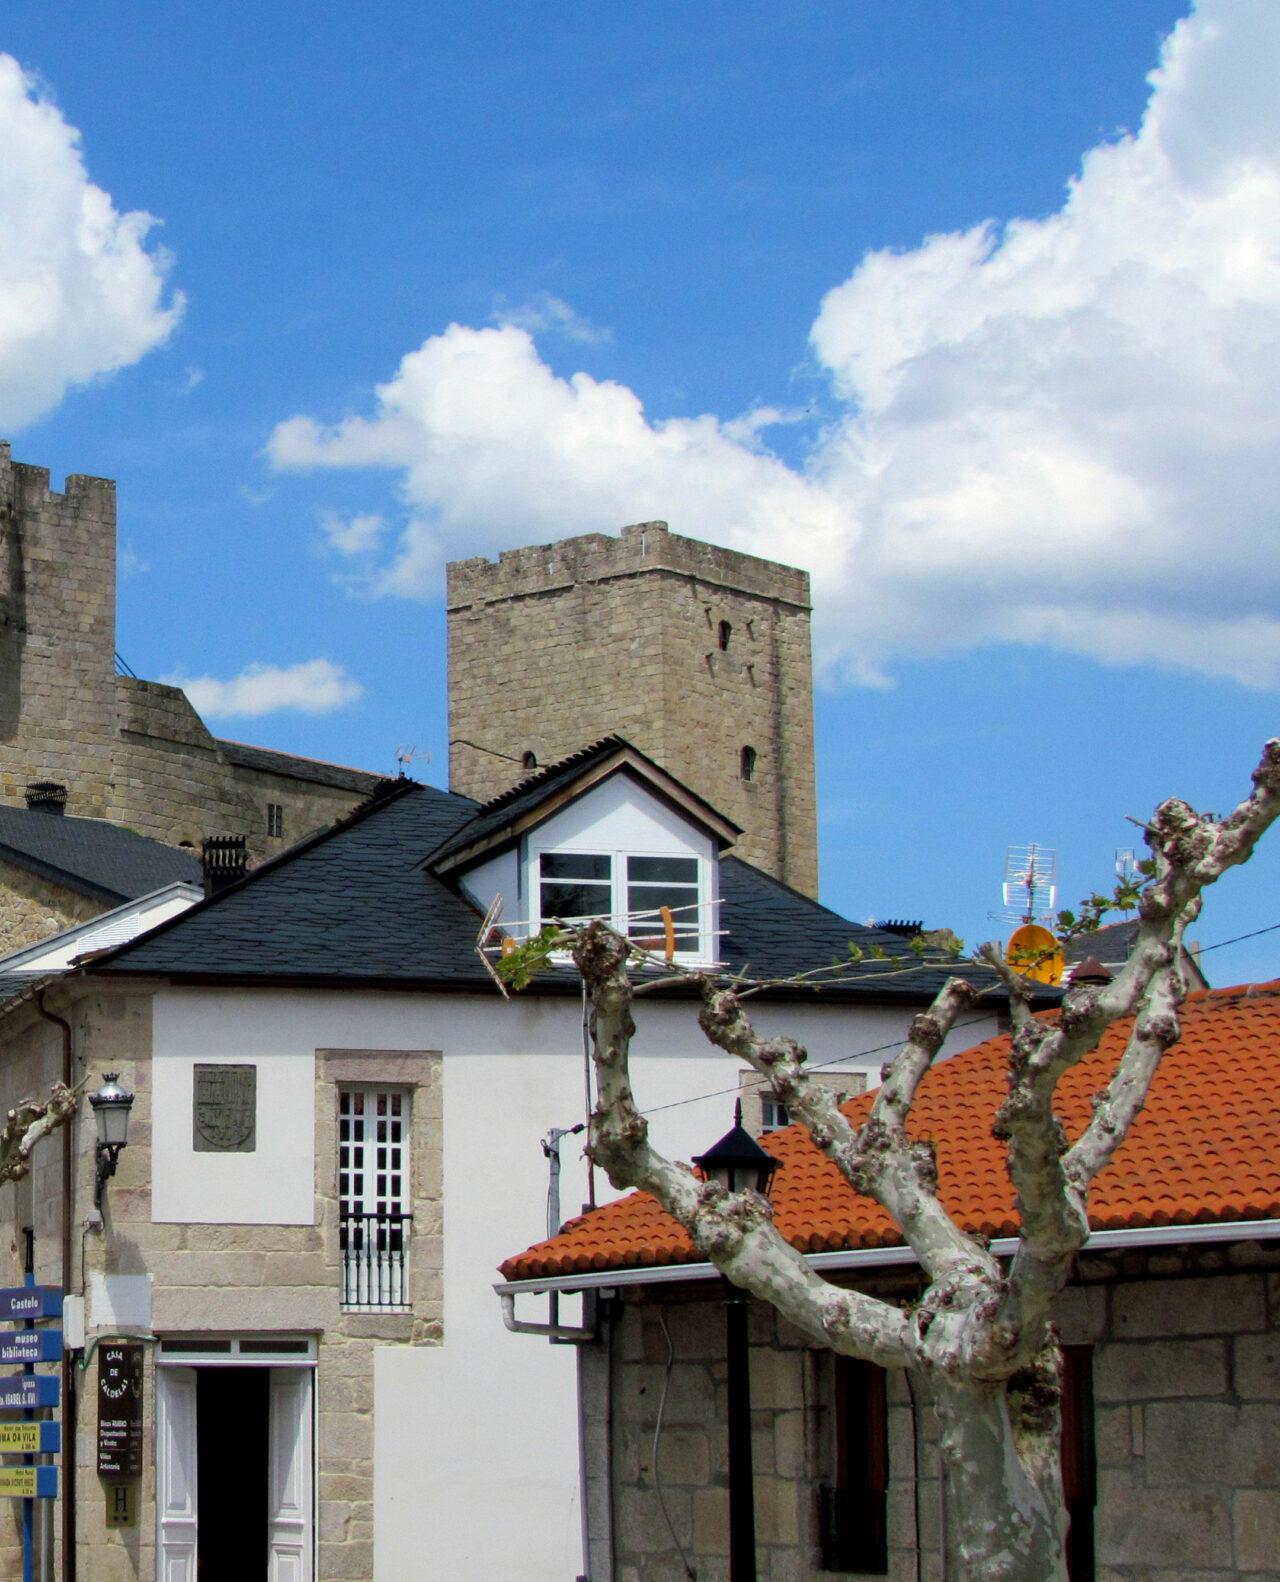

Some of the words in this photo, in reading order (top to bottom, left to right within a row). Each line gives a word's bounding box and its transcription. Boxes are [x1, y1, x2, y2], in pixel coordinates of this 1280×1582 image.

[10, 1296, 39, 1310] Castelo
[15, 1334, 39, 1344] museo
[1, 1346, 38, 1358] biblioteca
[106, 1350, 123, 1361] CASA
[110, 1368, 118, 1377] DE
[100, 1379, 128, 1398] CALDELAS
[12, 1432, 22, 1442] DA
[22, 1432, 36, 1442] VILA
[114, 1487, 127, 1513] H
